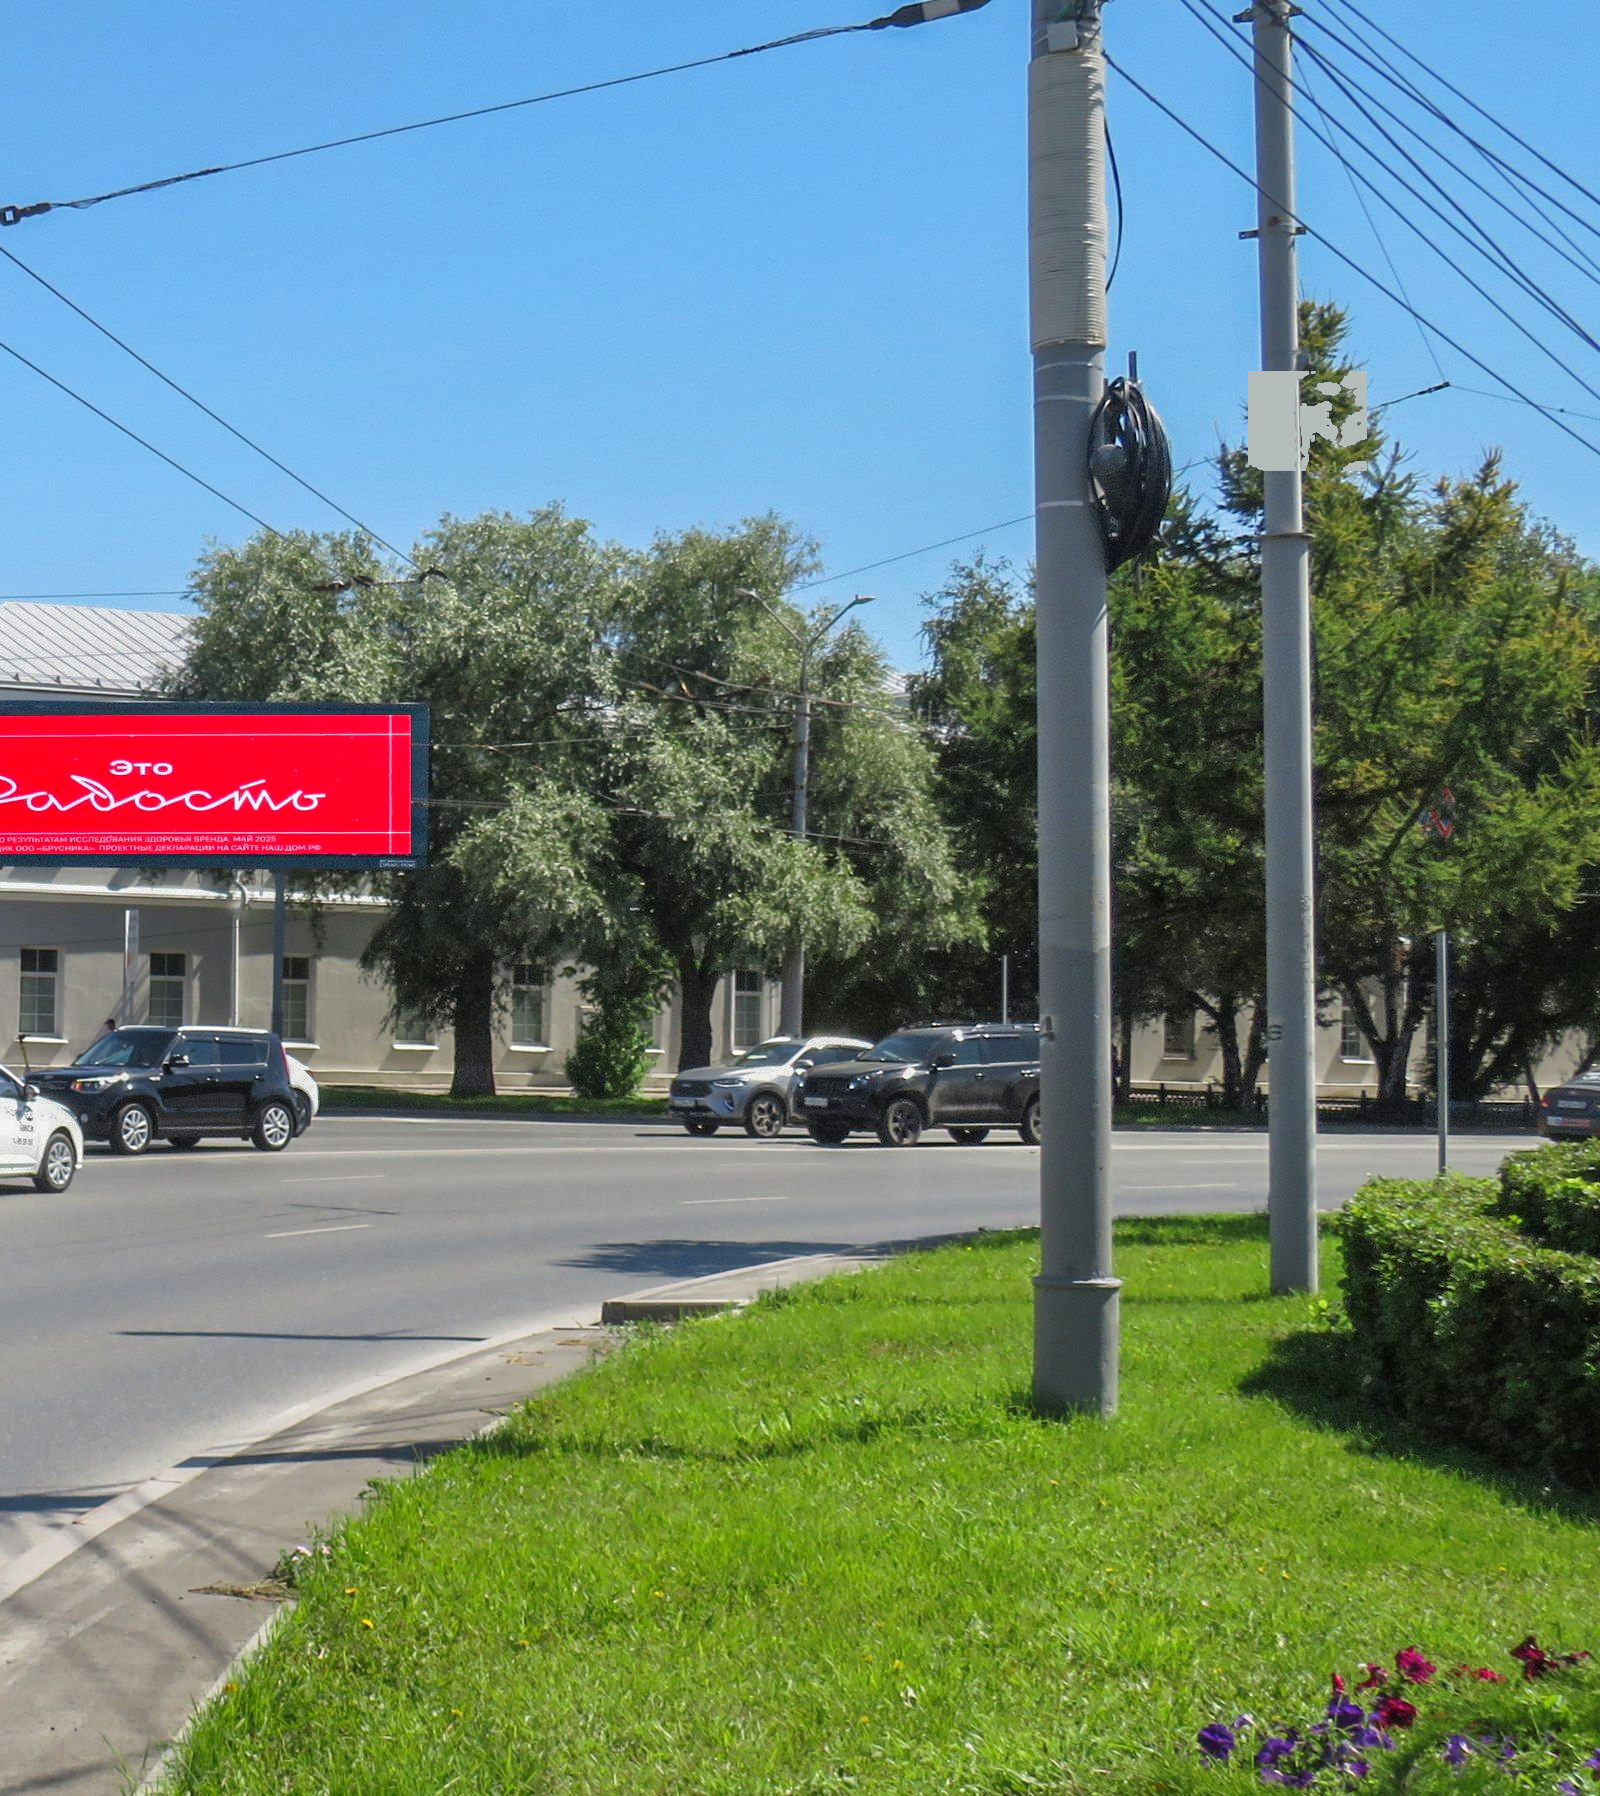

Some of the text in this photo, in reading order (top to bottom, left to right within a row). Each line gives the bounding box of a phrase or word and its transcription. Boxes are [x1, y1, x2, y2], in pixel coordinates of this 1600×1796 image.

[109, 759, 174, 776] Это
[69, 836, 143, 844] ИССЛЕДОВАНИЯ
[233, 834, 254, 843] МАЙ
[155, 845, 215, 853] ДЕКЛАРАЦИИ
[230, 843, 259, 852] САЙТЕ
